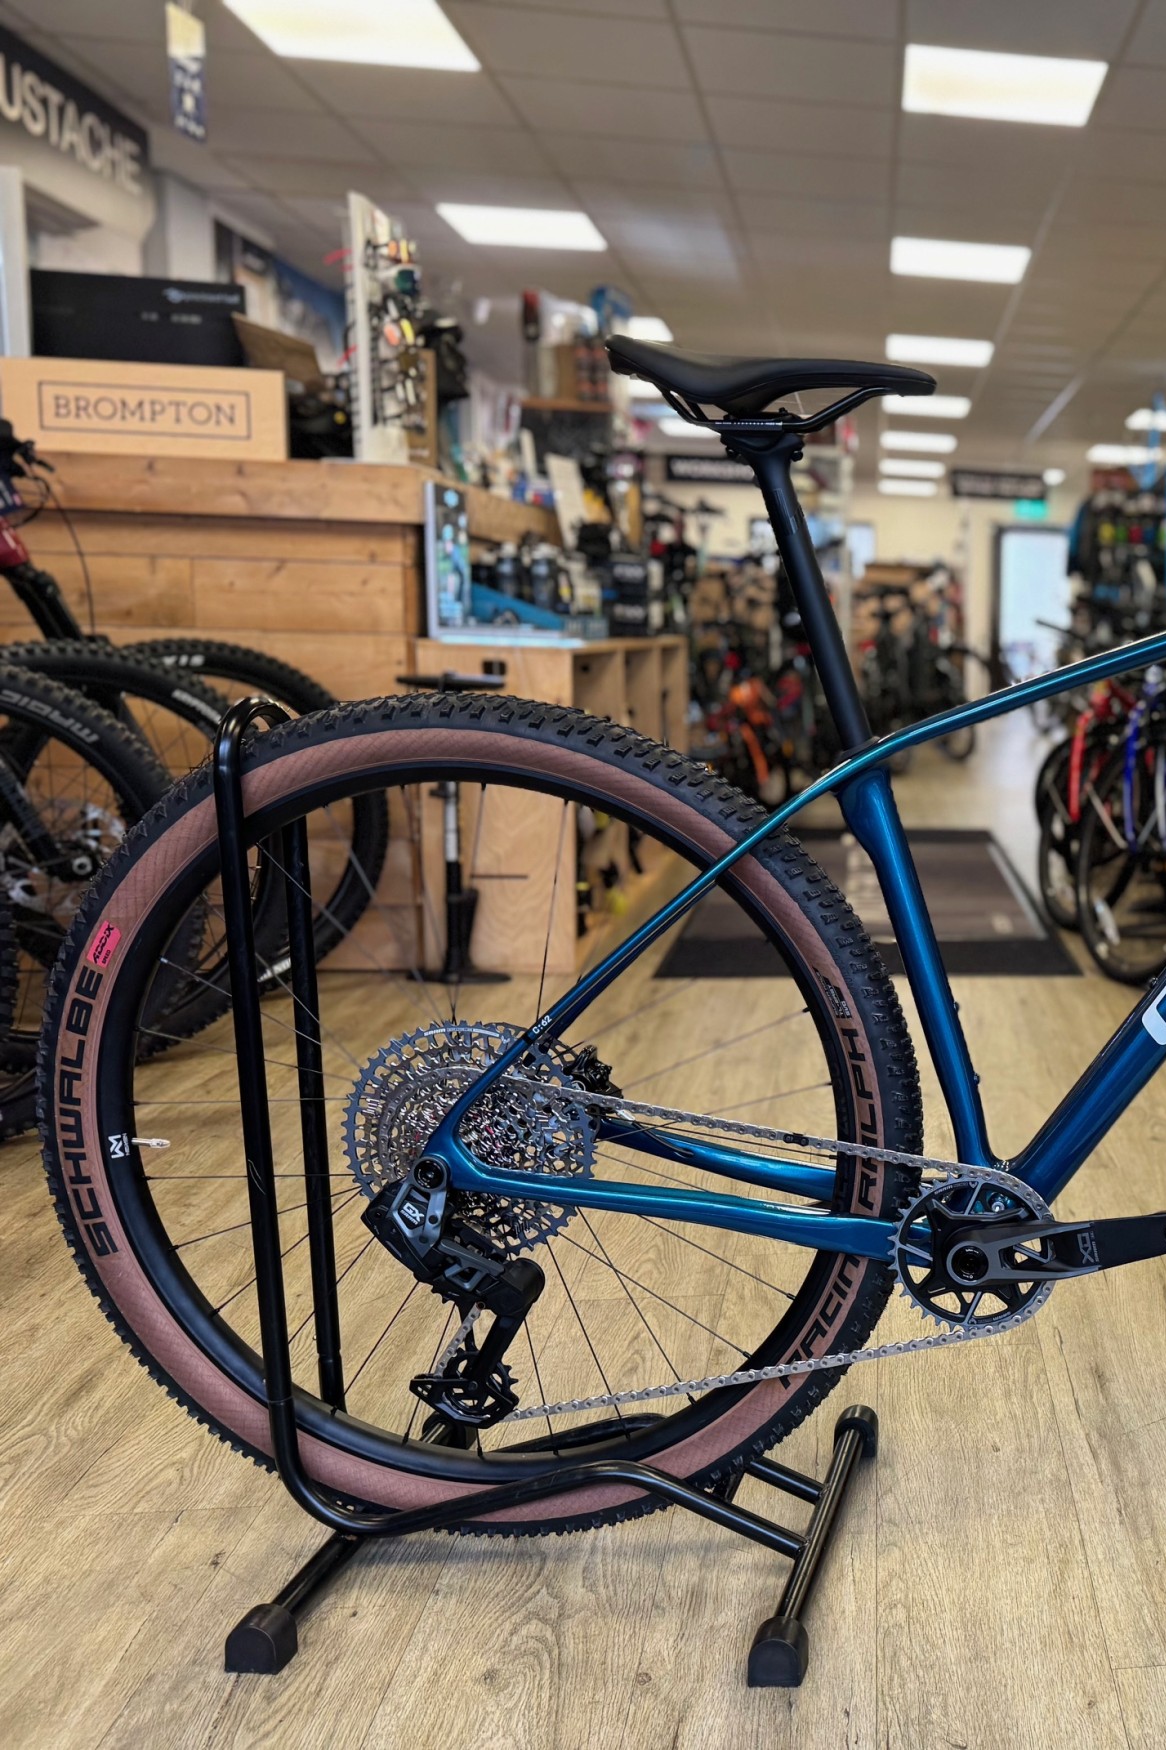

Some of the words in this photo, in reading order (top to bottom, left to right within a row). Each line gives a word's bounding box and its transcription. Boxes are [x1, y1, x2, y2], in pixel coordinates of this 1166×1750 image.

[53, 394, 236, 426] BROMPTON
[1, 688, 99, 745] MAGIC
[91, 922, 115, 965] ADDIX
[532, 1014, 553, 1035] C:62
[58, 964, 119, 1257] SCHWALBE
[402, 1202, 425, 1222] GX
